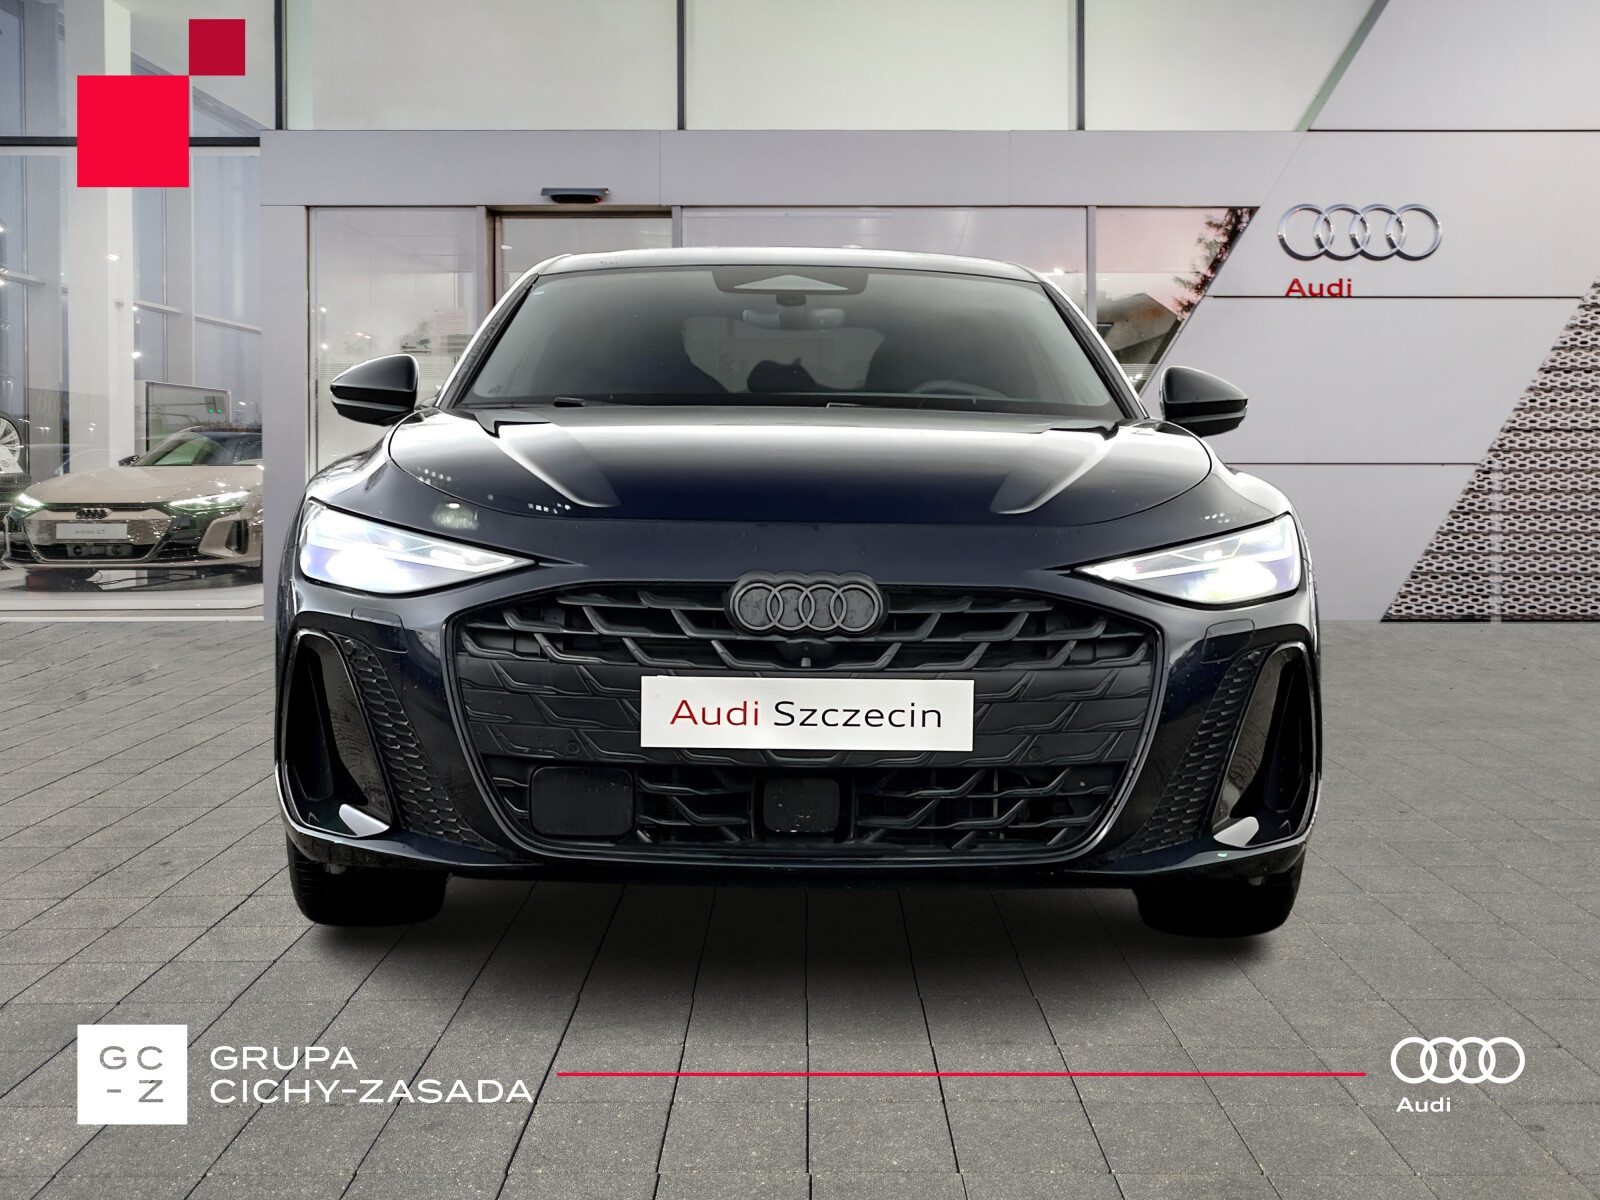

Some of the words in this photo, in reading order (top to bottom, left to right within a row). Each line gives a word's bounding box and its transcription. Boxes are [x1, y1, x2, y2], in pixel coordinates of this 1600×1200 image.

[1285, 277, 1352, 298] Audi
[670, 699, 759, 727] Audi
[774, 700, 943, 729] Szczecin
